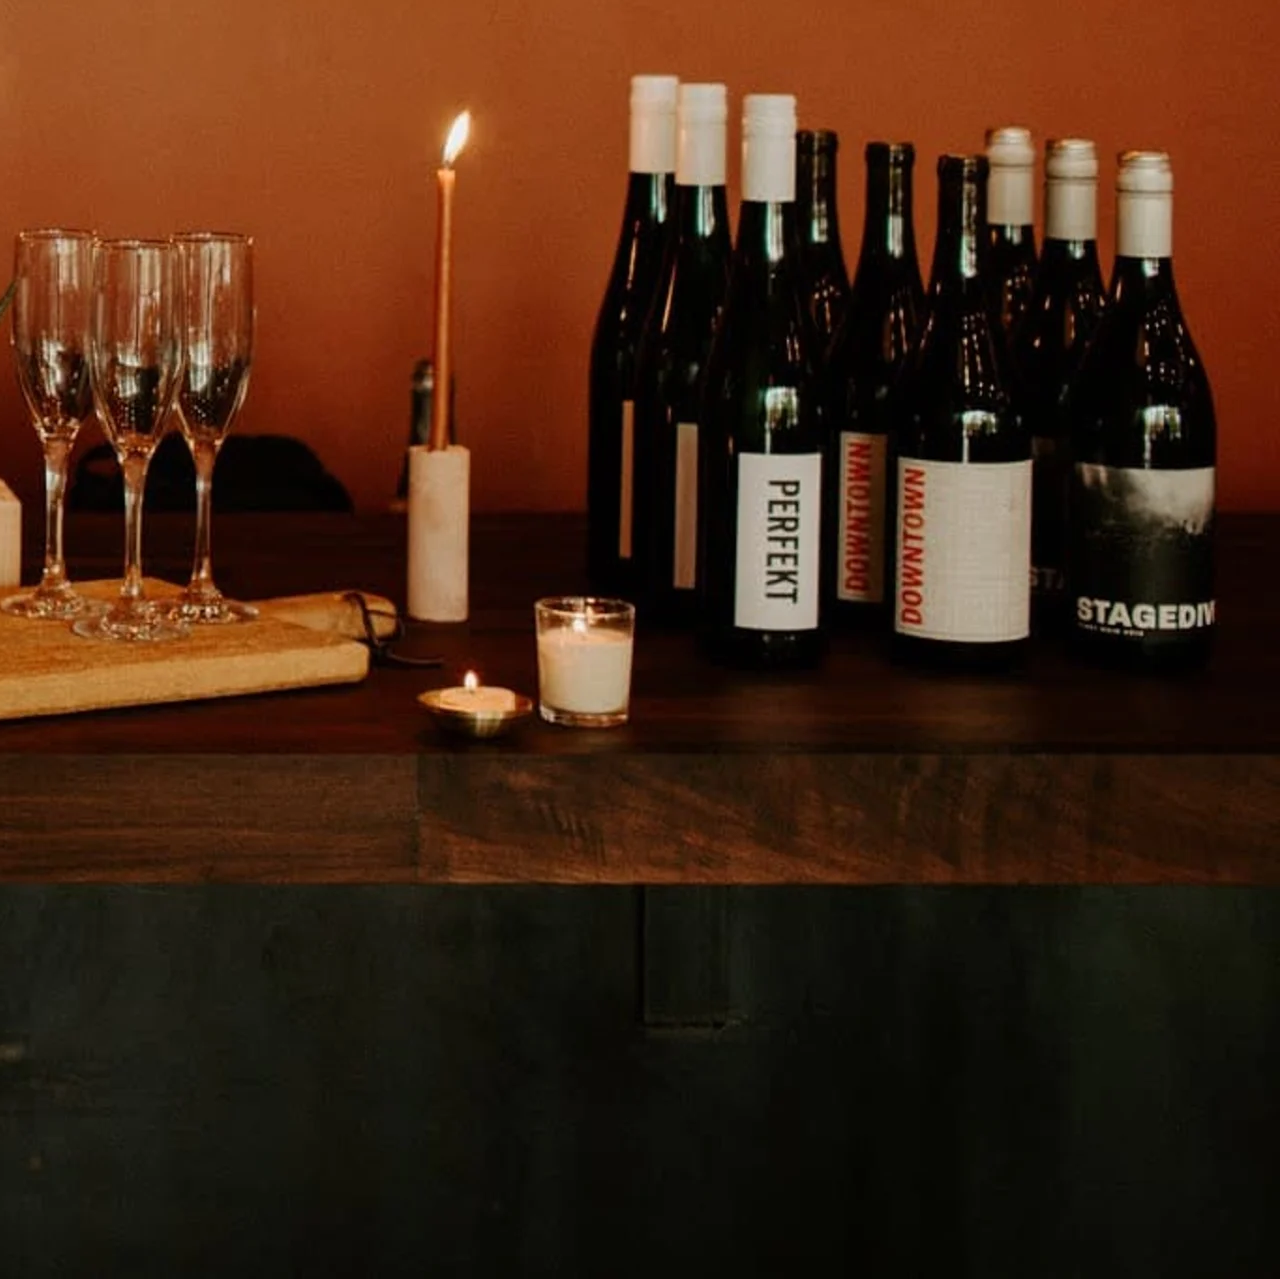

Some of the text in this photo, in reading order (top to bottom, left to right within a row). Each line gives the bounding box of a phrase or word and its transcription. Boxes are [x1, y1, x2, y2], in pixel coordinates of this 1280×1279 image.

[765, 480, 800, 604] PERFEKT
[845, 442, 871, 593] DOWNTOWN
[901, 468, 926, 625] DOWNTOWN
